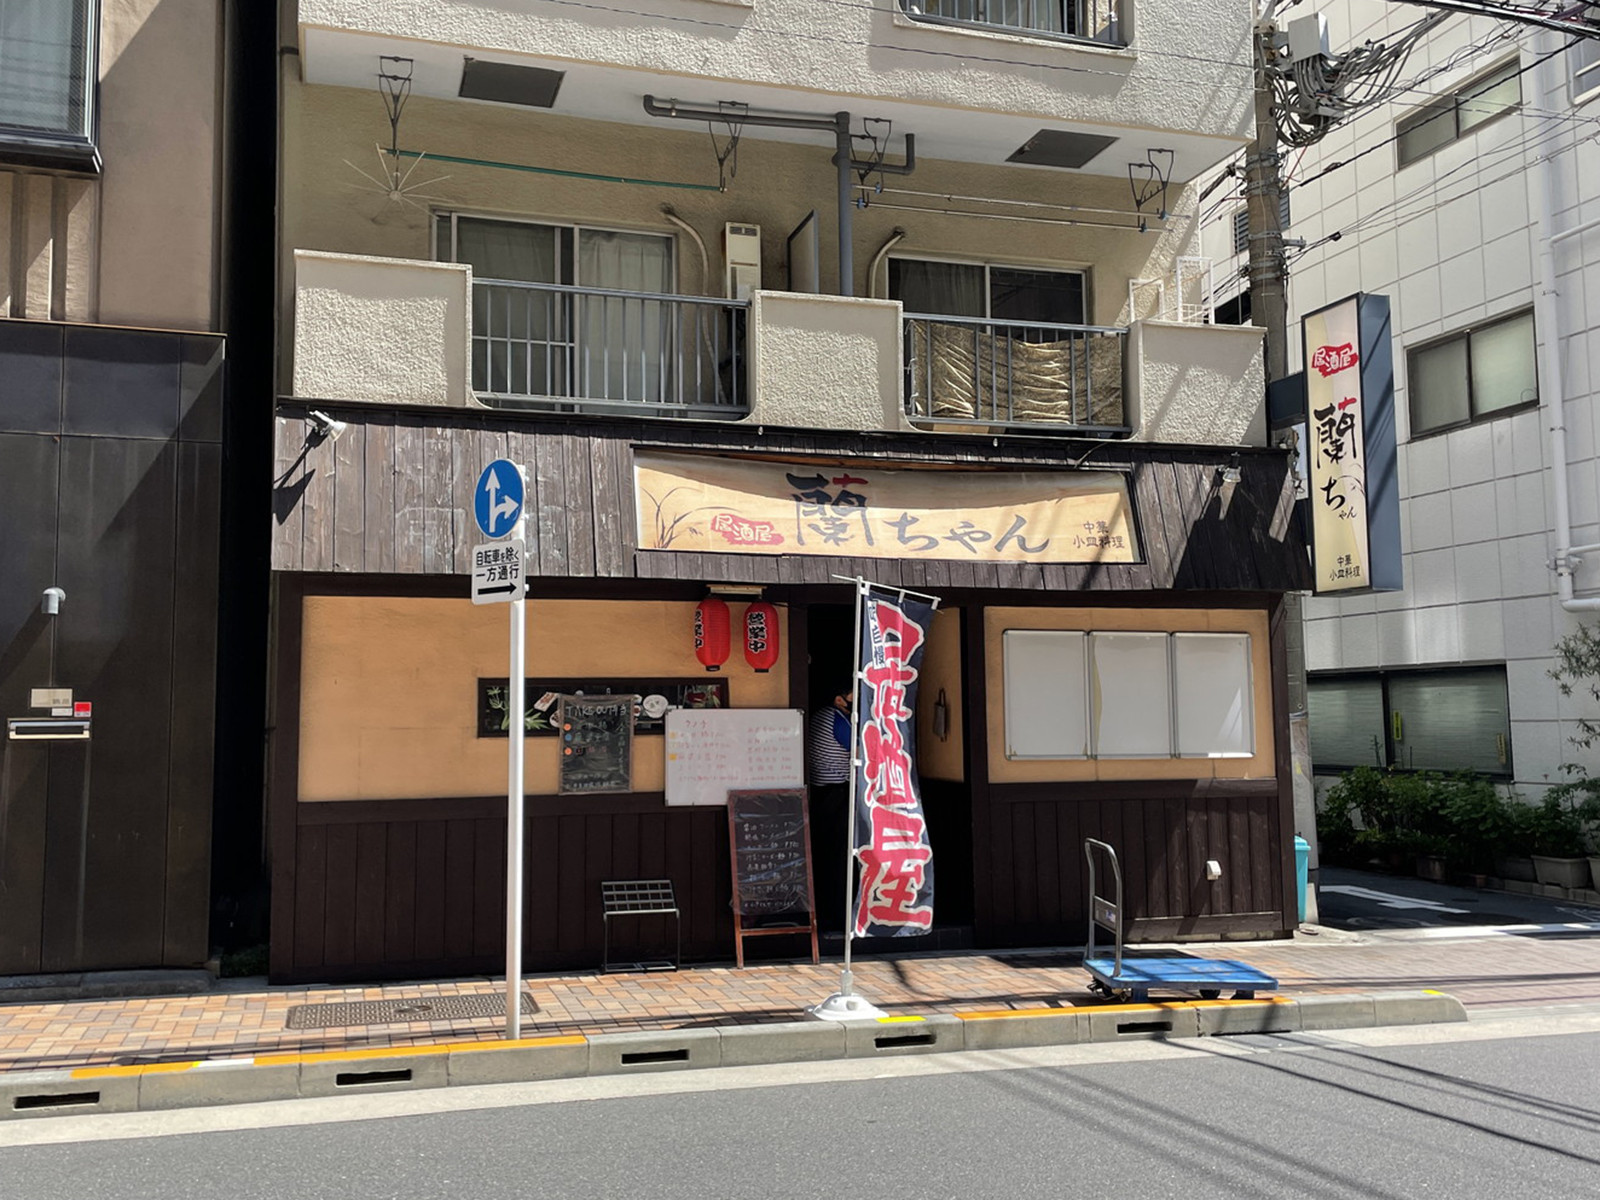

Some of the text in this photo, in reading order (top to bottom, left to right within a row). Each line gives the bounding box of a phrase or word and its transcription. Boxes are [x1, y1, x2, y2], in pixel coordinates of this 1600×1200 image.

[1313, 347, 1351, 372] 居酒屋
[1314, 397, 1357, 519] 蘭ちゃん
[785, 472, 1051, 555] 蘭ちゃん
[715, 514, 772, 541] 居酒屋
[1073, 535, 1125, 549] 小皿料理
[476, 547, 519, 566] 自転車を除く
[476, 564, 520, 582] 一方通行
